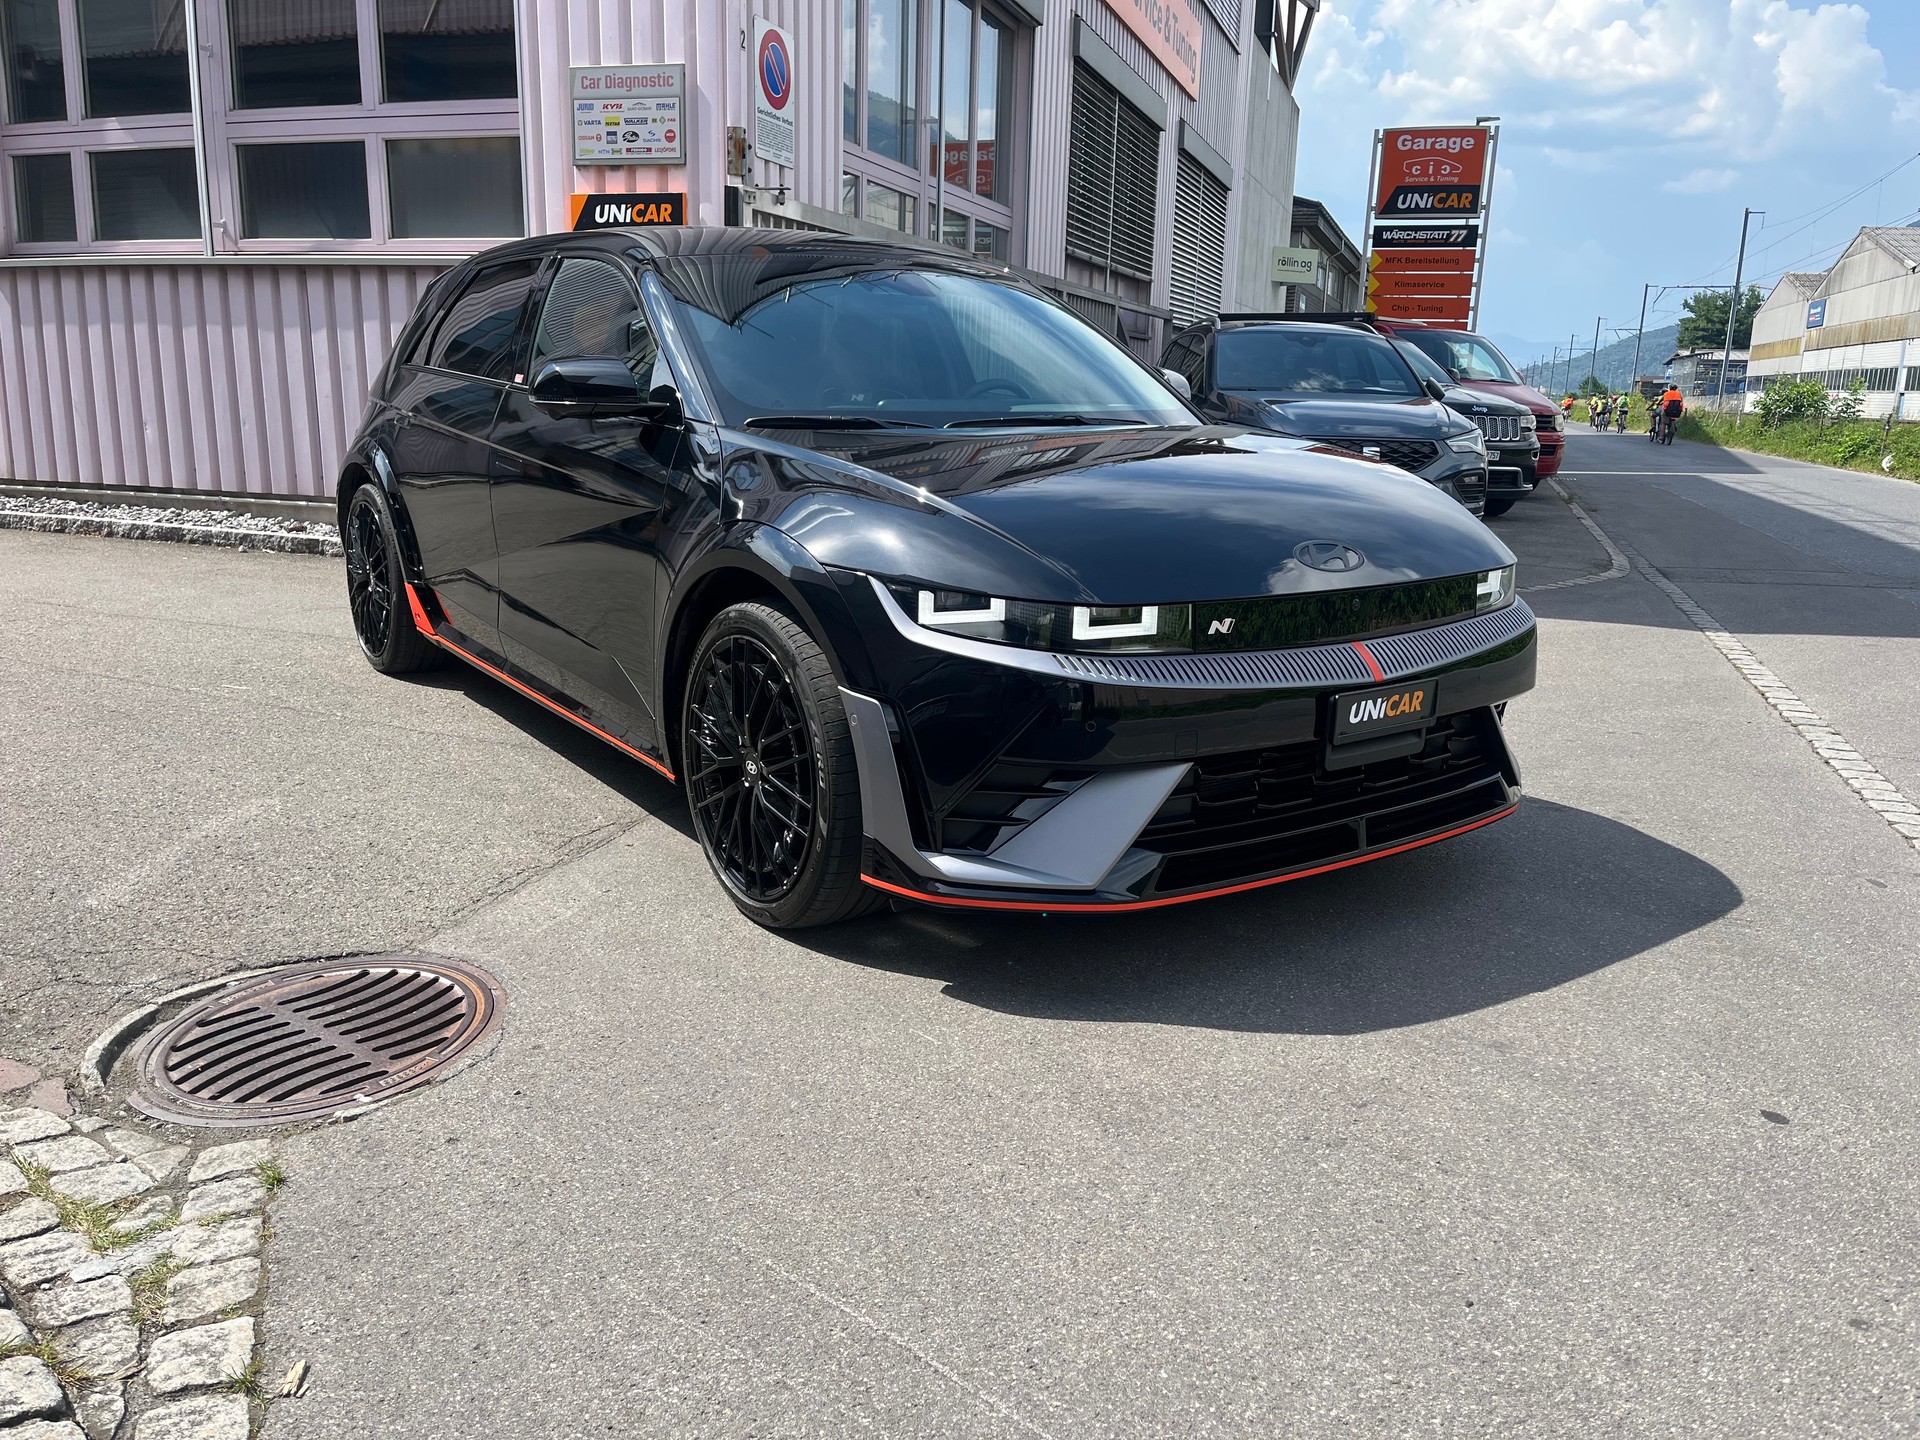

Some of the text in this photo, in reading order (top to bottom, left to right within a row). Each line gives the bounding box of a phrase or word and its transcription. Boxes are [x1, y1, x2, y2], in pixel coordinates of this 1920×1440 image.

[740, 30, 746, 50] 2
[1172, 12, 1197, 84] Tuning
[581, 72, 674, 92] Car Diagnostic
[757, 106, 781, 122] Gerichtliches
[1397, 134, 1475, 153] Garage
[1449, 229, 1468, 242] 77
[1277, 256, 1312, 272] röllin ag
[1405, 257, 1460, 265] Bereitstellung
[1391, 304, 1410, 313] Chip
[1417, 305, 1444, 313] Tuning
[1472, 405, 1488, 413] Jeep
